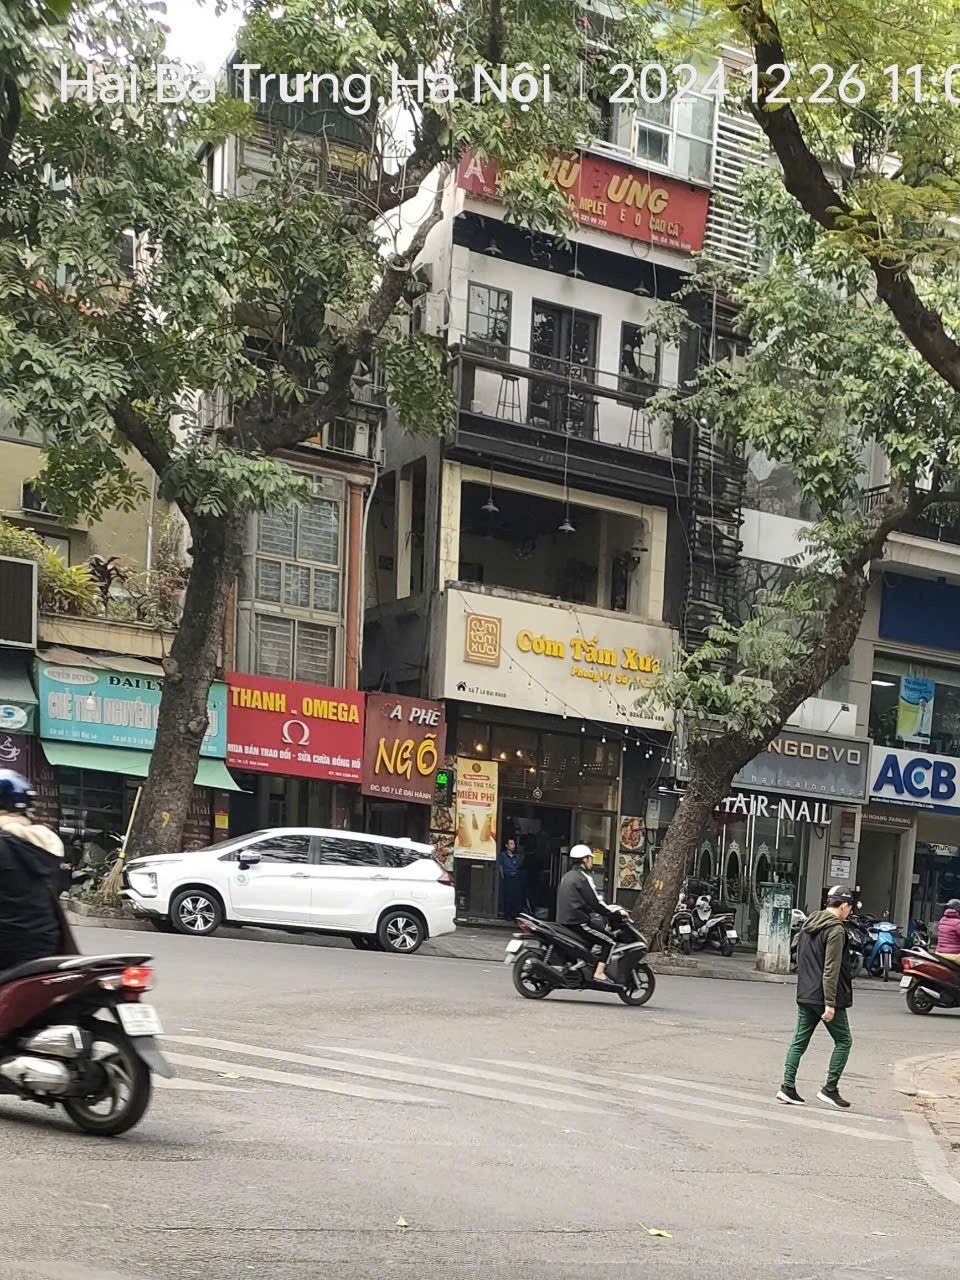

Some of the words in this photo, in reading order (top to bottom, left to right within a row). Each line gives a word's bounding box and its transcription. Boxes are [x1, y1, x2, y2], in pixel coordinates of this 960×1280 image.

[516, 629, 565, 659] Cơm
[569, 634, 617, 668] Tấm
[108, 675, 141, 690] ĐẠI
[230, 686, 286, 713] THANH
[302, 697, 360, 724] OMEGA
[408, 706, 441, 726] PHÊ
[872, 753, 957, 800] ACB
